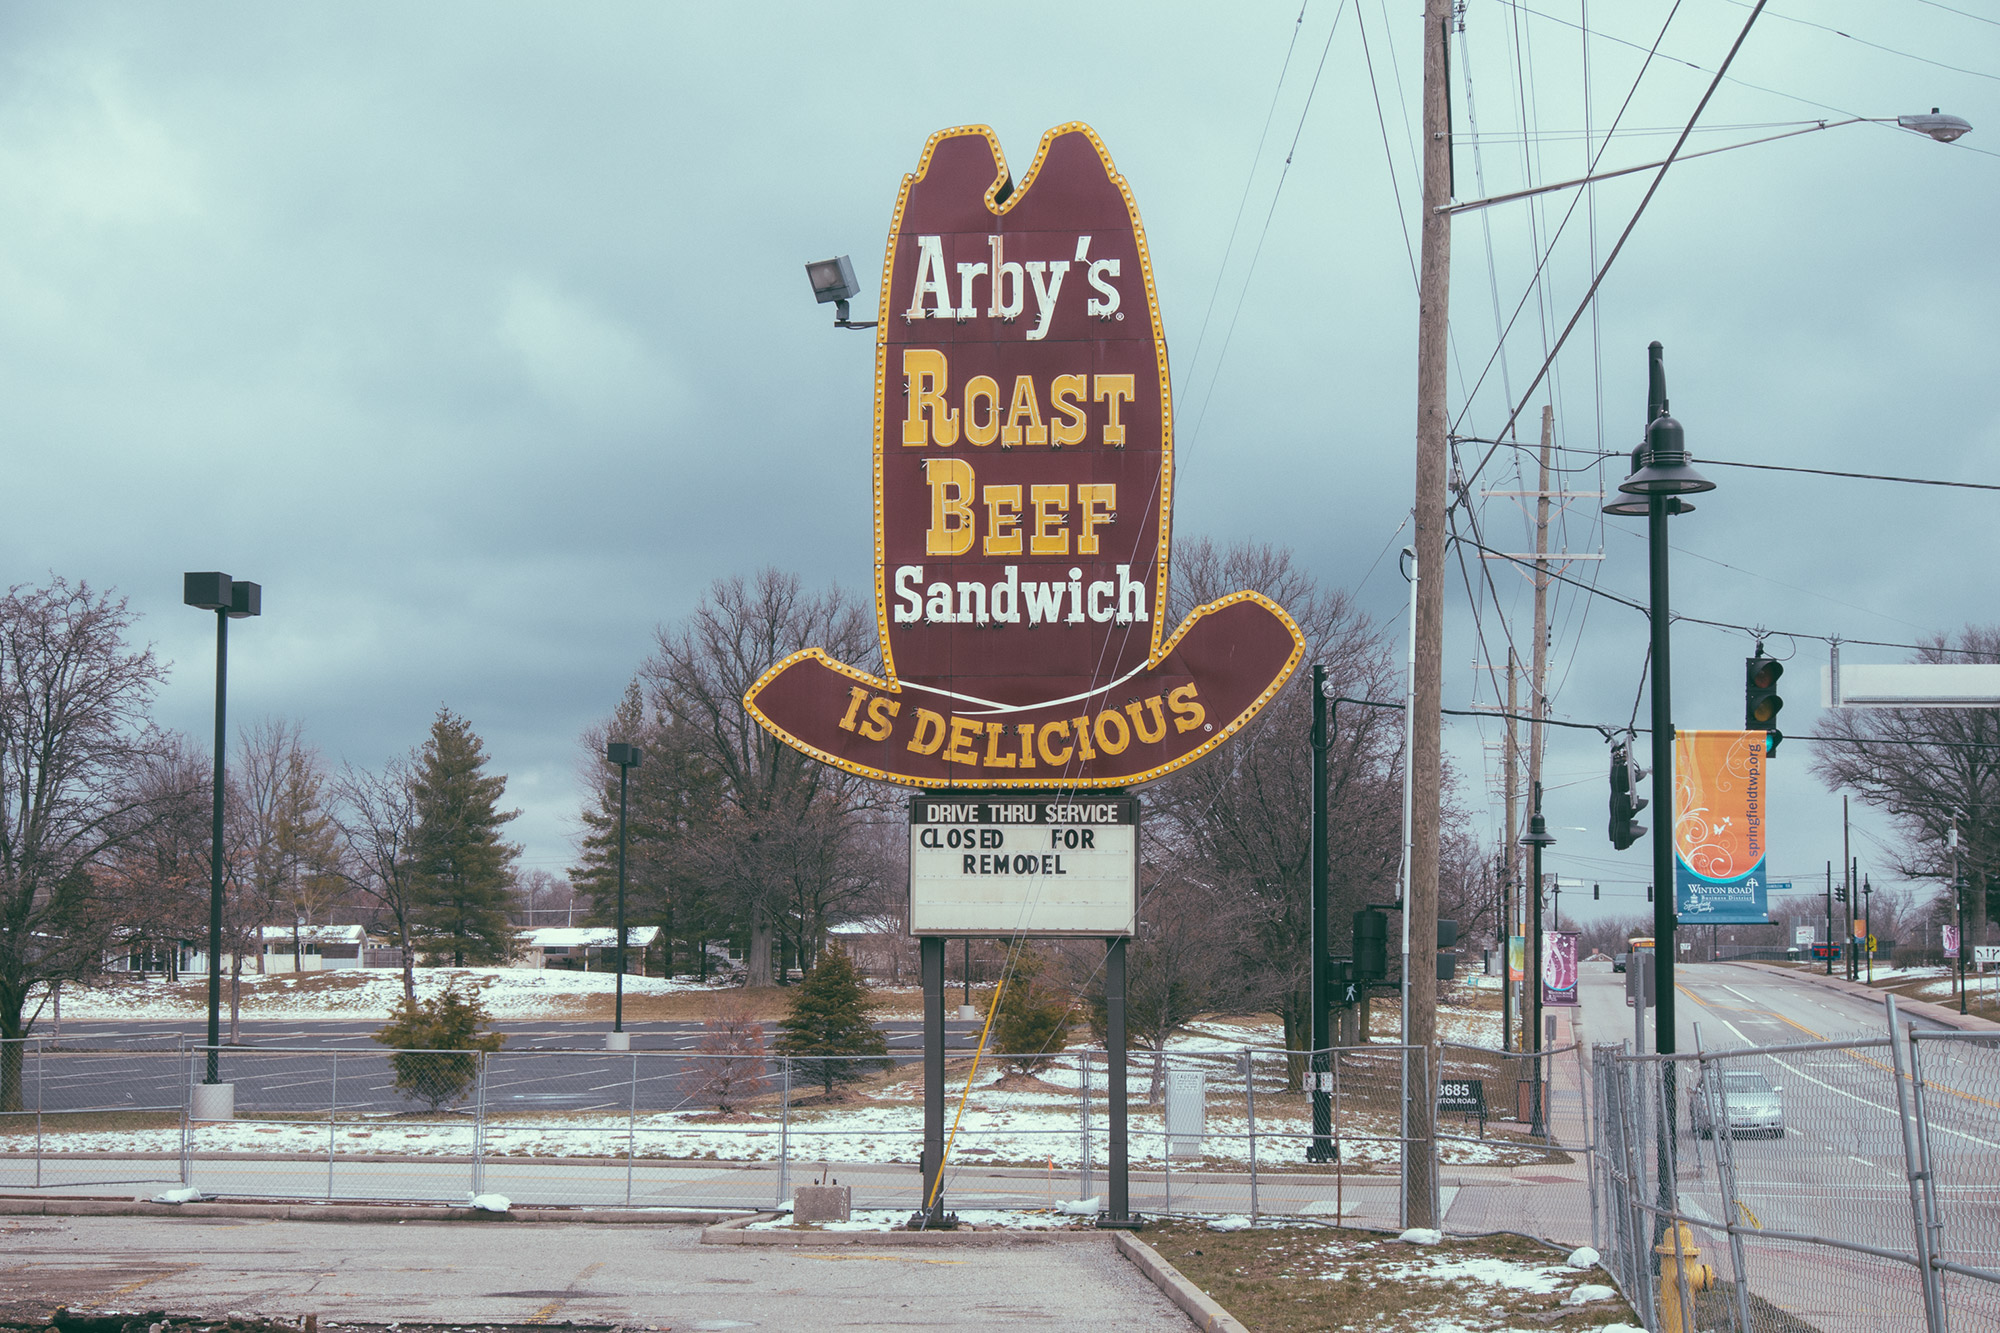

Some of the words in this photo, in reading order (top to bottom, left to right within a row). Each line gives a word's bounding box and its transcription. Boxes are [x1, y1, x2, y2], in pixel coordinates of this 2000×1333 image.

[906, 235, 1121, 341] Arby's
[902, 348, 1135, 447] ROAST
[925, 458, 1117, 556] BEEF
[894, 564, 1149, 624] Sandwich
[838, 685, 902, 742] IS
[906, 682, 1206, 769] DELICIOUS
[927, 804, 979, 823] DRIVE
[988, 804, 1036, 823] THRU
[1045, 804, 1118, 823] SERVICE
[1745, 743, 1761, 857] springfieldtwp.org
[920, 828, 1004, 849] CLOSED
[1051, 828, 1095, 849] FOR
[962, 854, 1067, 875] REMODEL
[1688, 884, 1726, 894] WINTON
